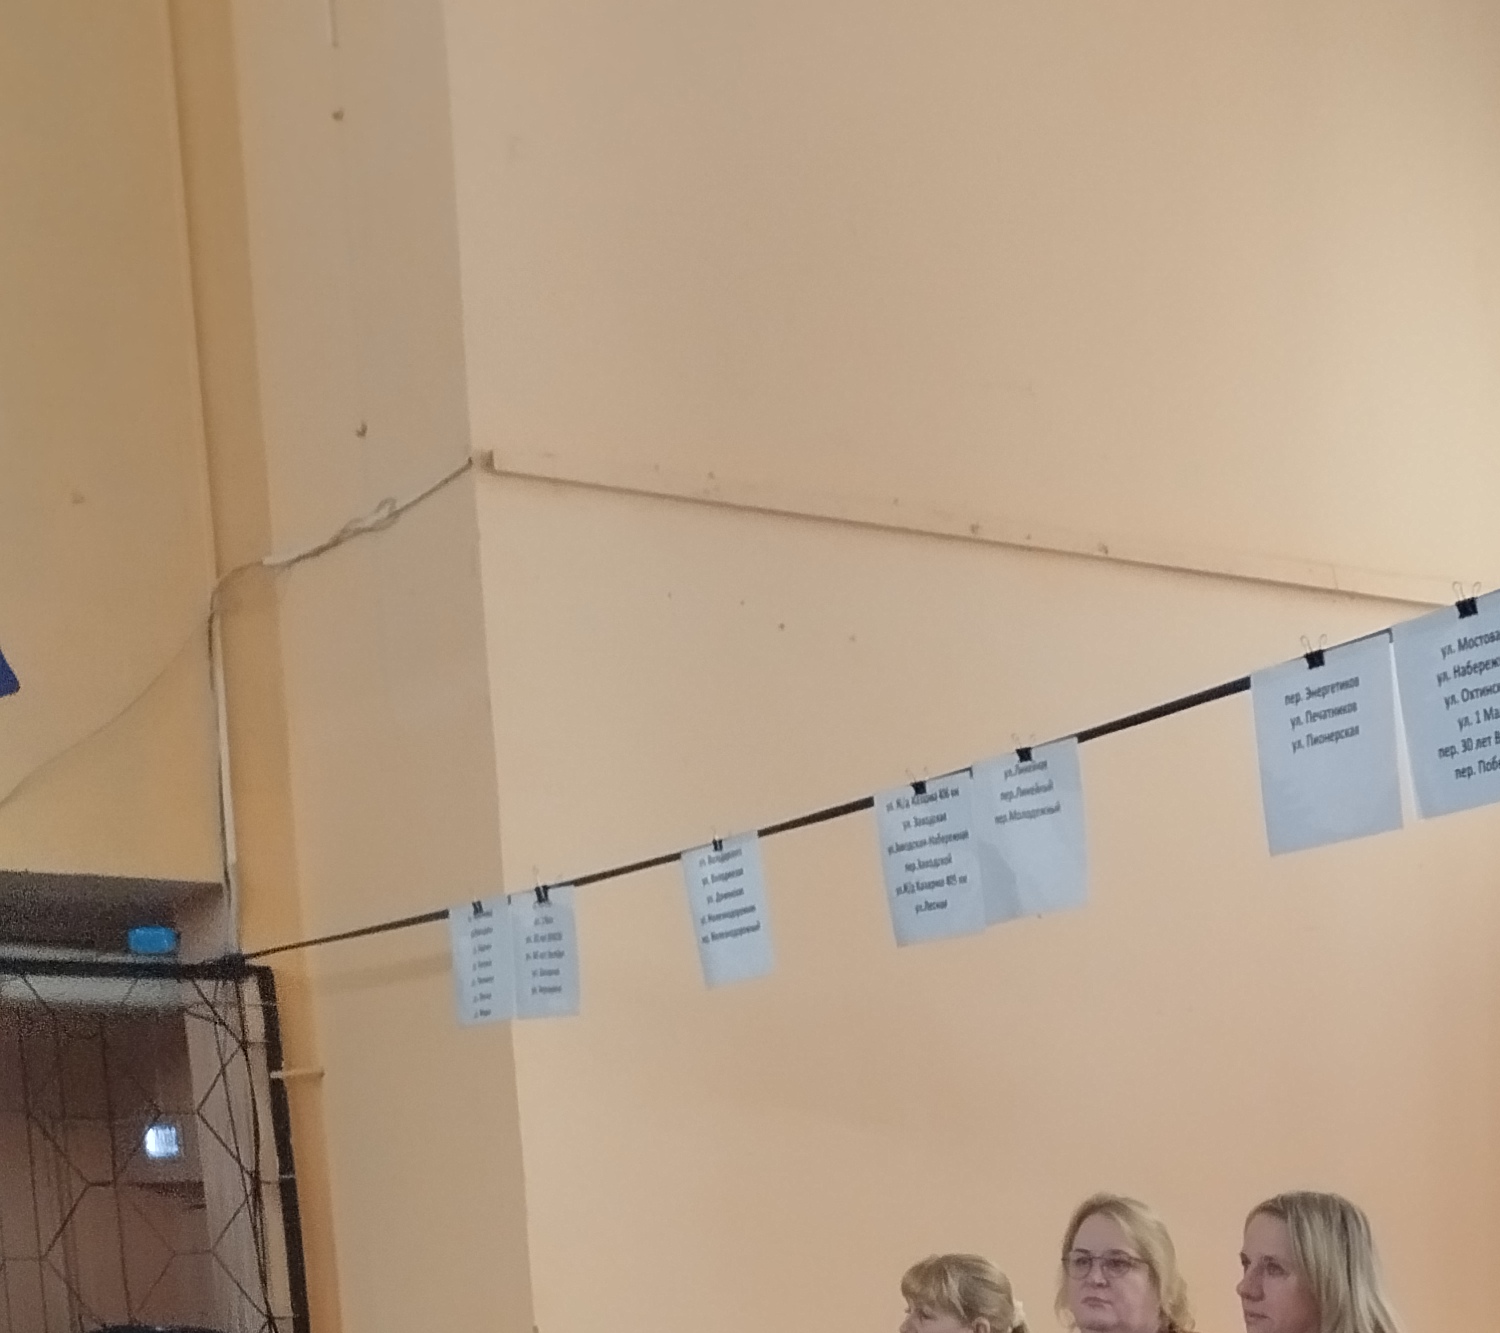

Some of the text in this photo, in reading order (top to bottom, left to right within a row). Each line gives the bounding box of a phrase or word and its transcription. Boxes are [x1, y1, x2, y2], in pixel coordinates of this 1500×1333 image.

[1440, 644, 1456, 660] ул.
[1436, 671, 1451, 687] ул.
[1284, 676, 1360, 707] пер. Энергетиков
[1444, 694, 1459, 710] ул.
[1290, 701, 1358, 732] ул. Печатников
[1457, 716, 1473, 732] ул.
[1475, 710, 1481, 724] 1
[1292, 725, 1360, 755] ул. Пионерская
[1438, 745, 1459, 760] пер.
[1461, 737, 1473, 753] 30
[1475, 736, 1492, 750] лет
[1454, 765, 1476, 780] пер.
